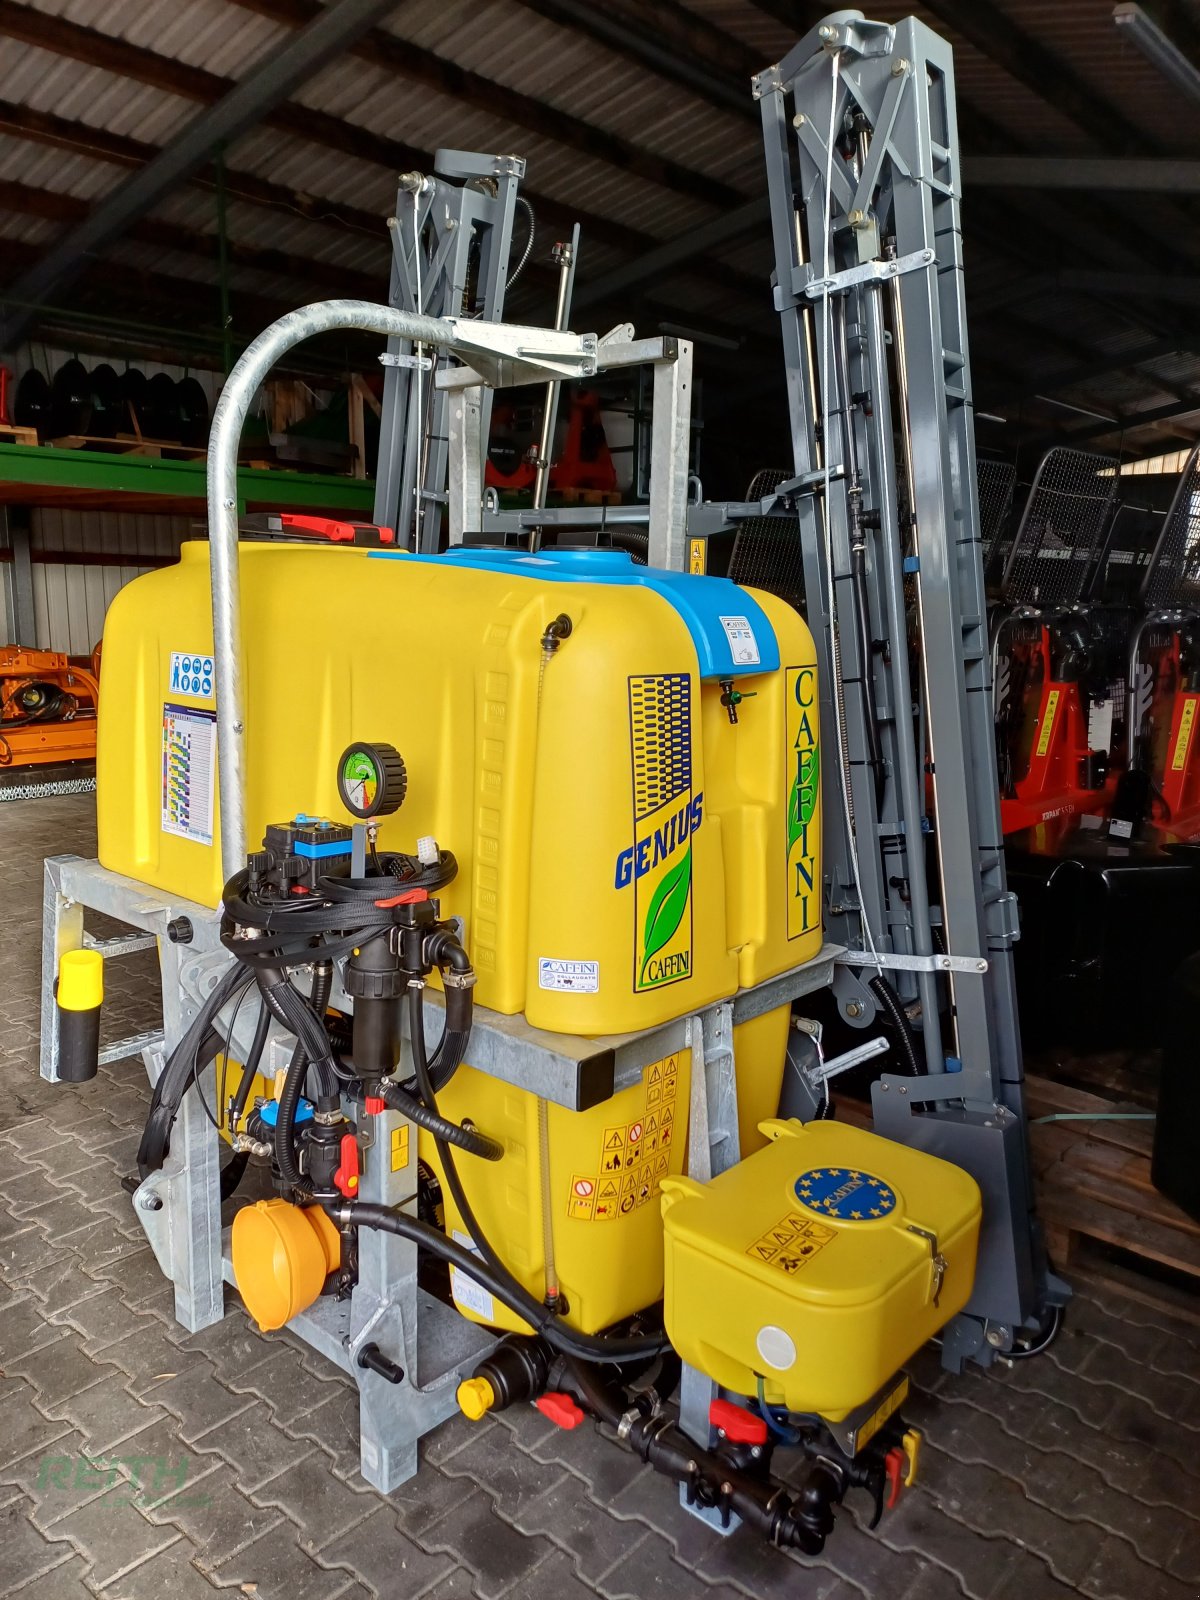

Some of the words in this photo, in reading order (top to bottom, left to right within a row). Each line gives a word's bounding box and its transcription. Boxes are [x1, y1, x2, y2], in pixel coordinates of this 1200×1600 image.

[795, 670, 815, 931] CAFFINI
[614, 792, 703, 890] GENIUS
[550, 962, 595, 973] CAFFINI
[648, 950, 690, 981] CAFFINI
